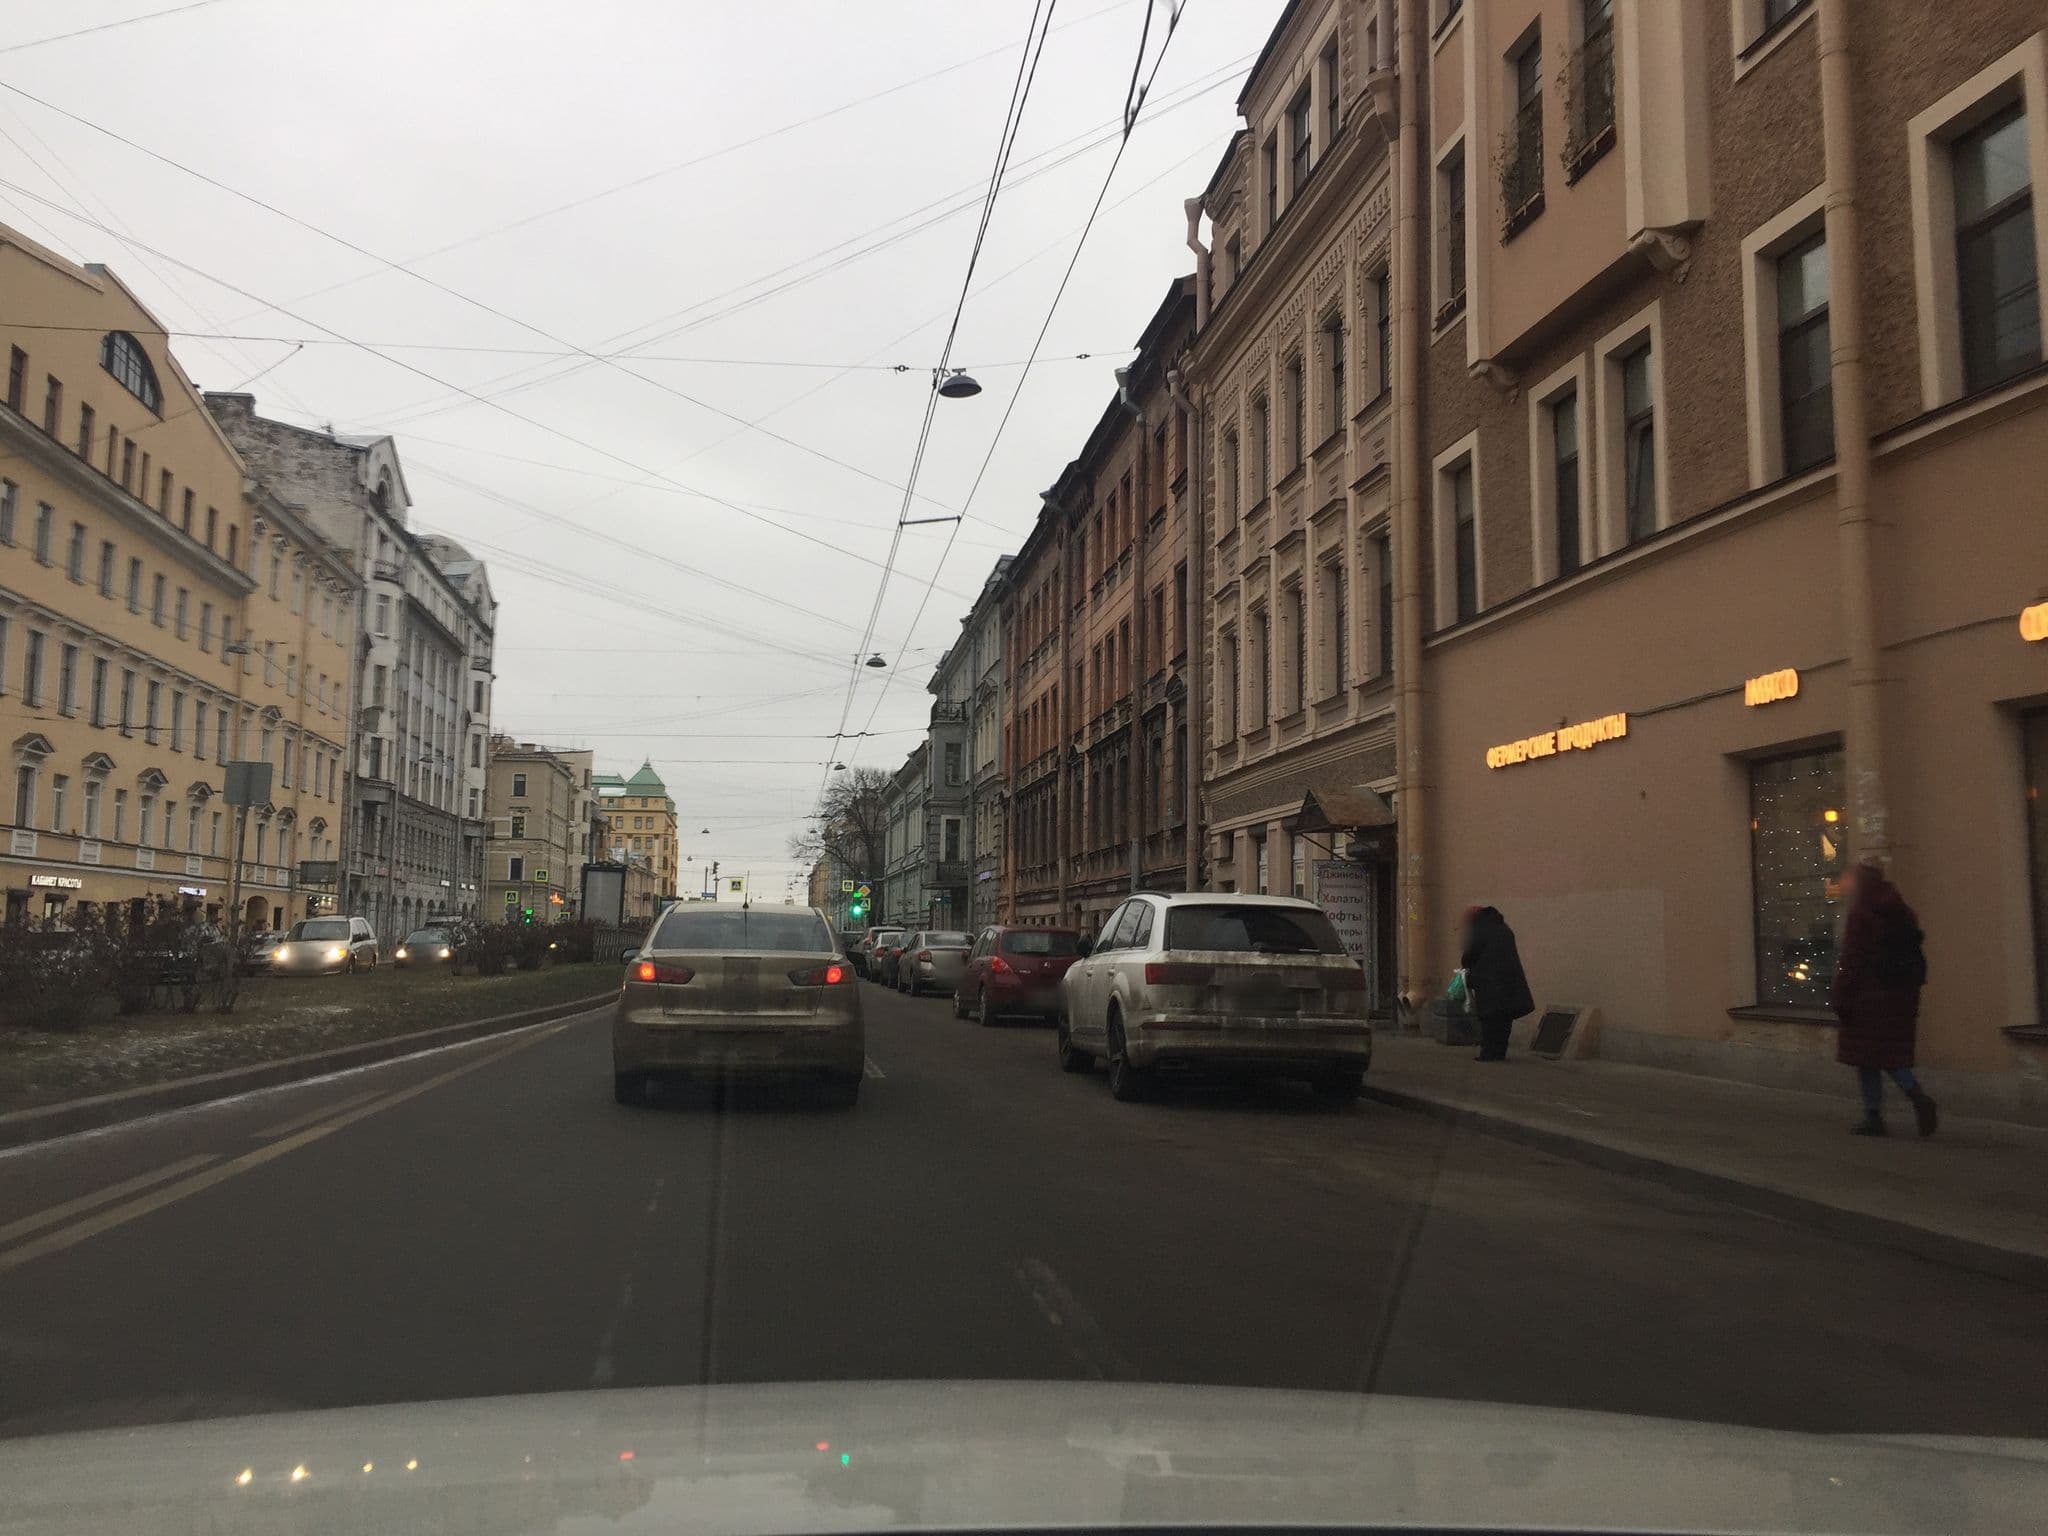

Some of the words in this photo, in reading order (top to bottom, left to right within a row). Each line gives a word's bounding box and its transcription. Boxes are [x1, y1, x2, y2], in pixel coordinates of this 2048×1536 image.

[1486, 731, 1557, 769] ФЕРМЕРСКИЕ
[1556, 712, 1627, 752] ПРОДУКТЫ
[57, 877, 82, 889] КРАСОТЫ
[1323, 893, 1363, 904] Халаты
